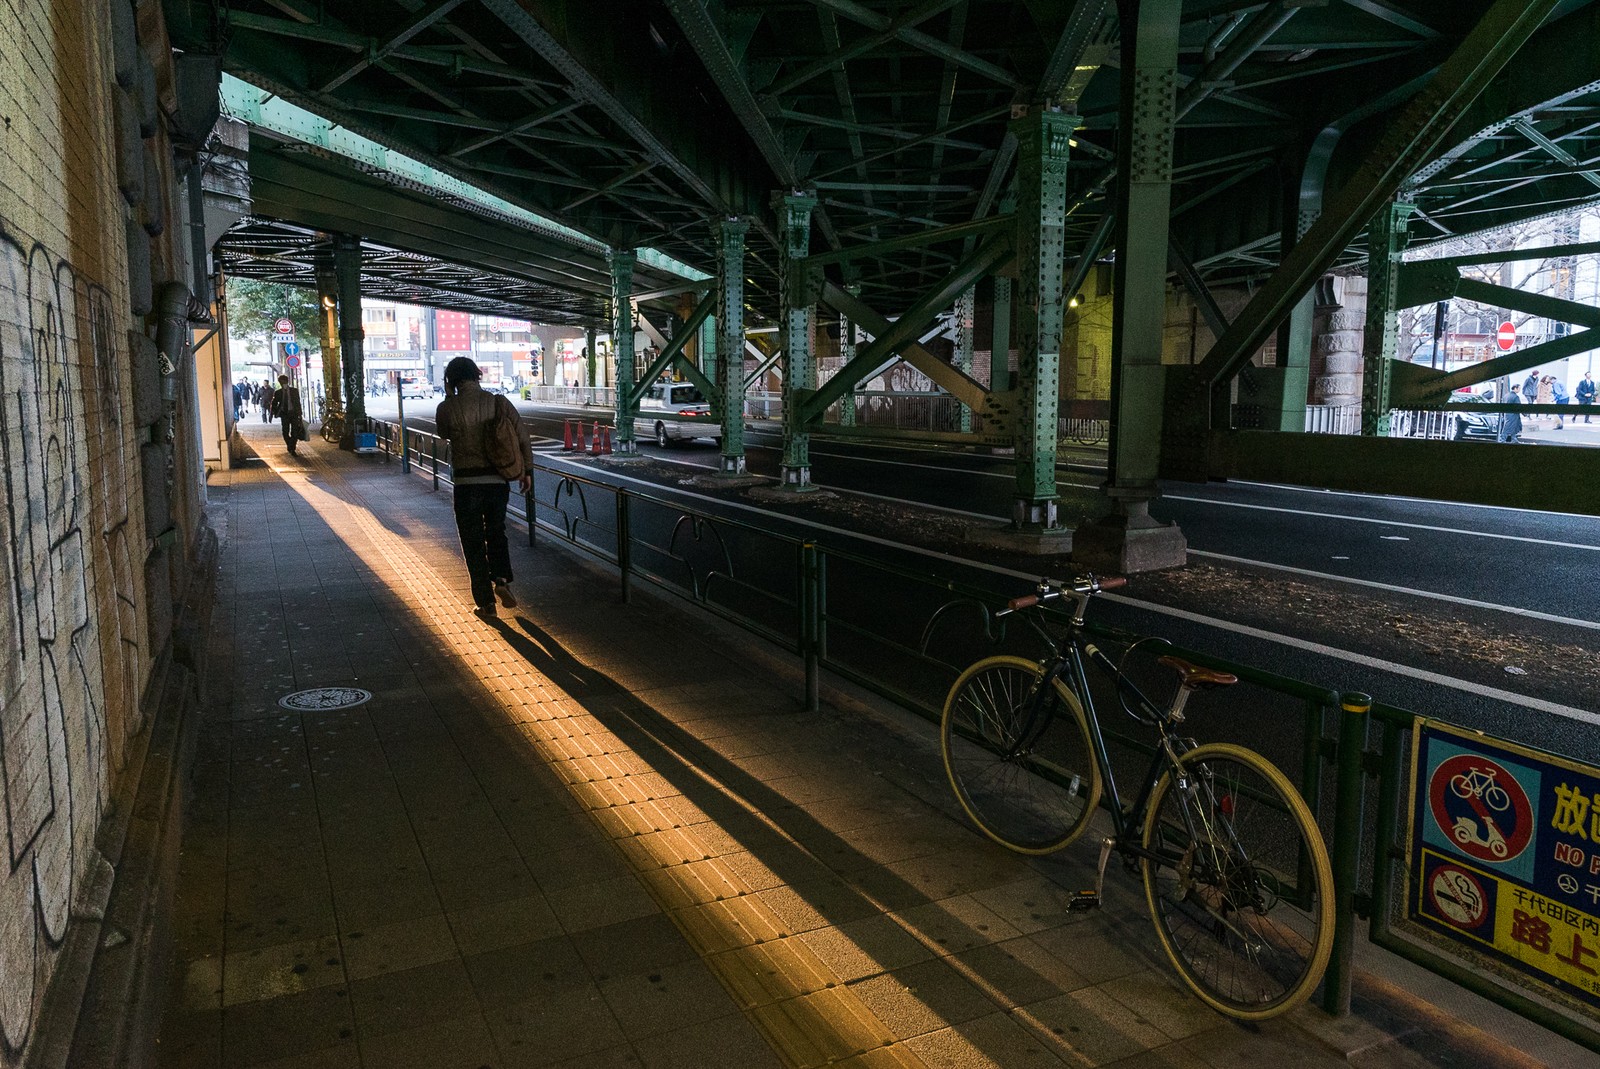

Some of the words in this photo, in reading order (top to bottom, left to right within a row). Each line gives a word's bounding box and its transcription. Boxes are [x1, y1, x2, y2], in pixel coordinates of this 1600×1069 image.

[1552, 782, 1600, 843] 放
[1554, 841, 1585, 867] NO
[1512, 889, 1598, 936] 千代田区内
[1510, 908, 1598, 976] 路上
